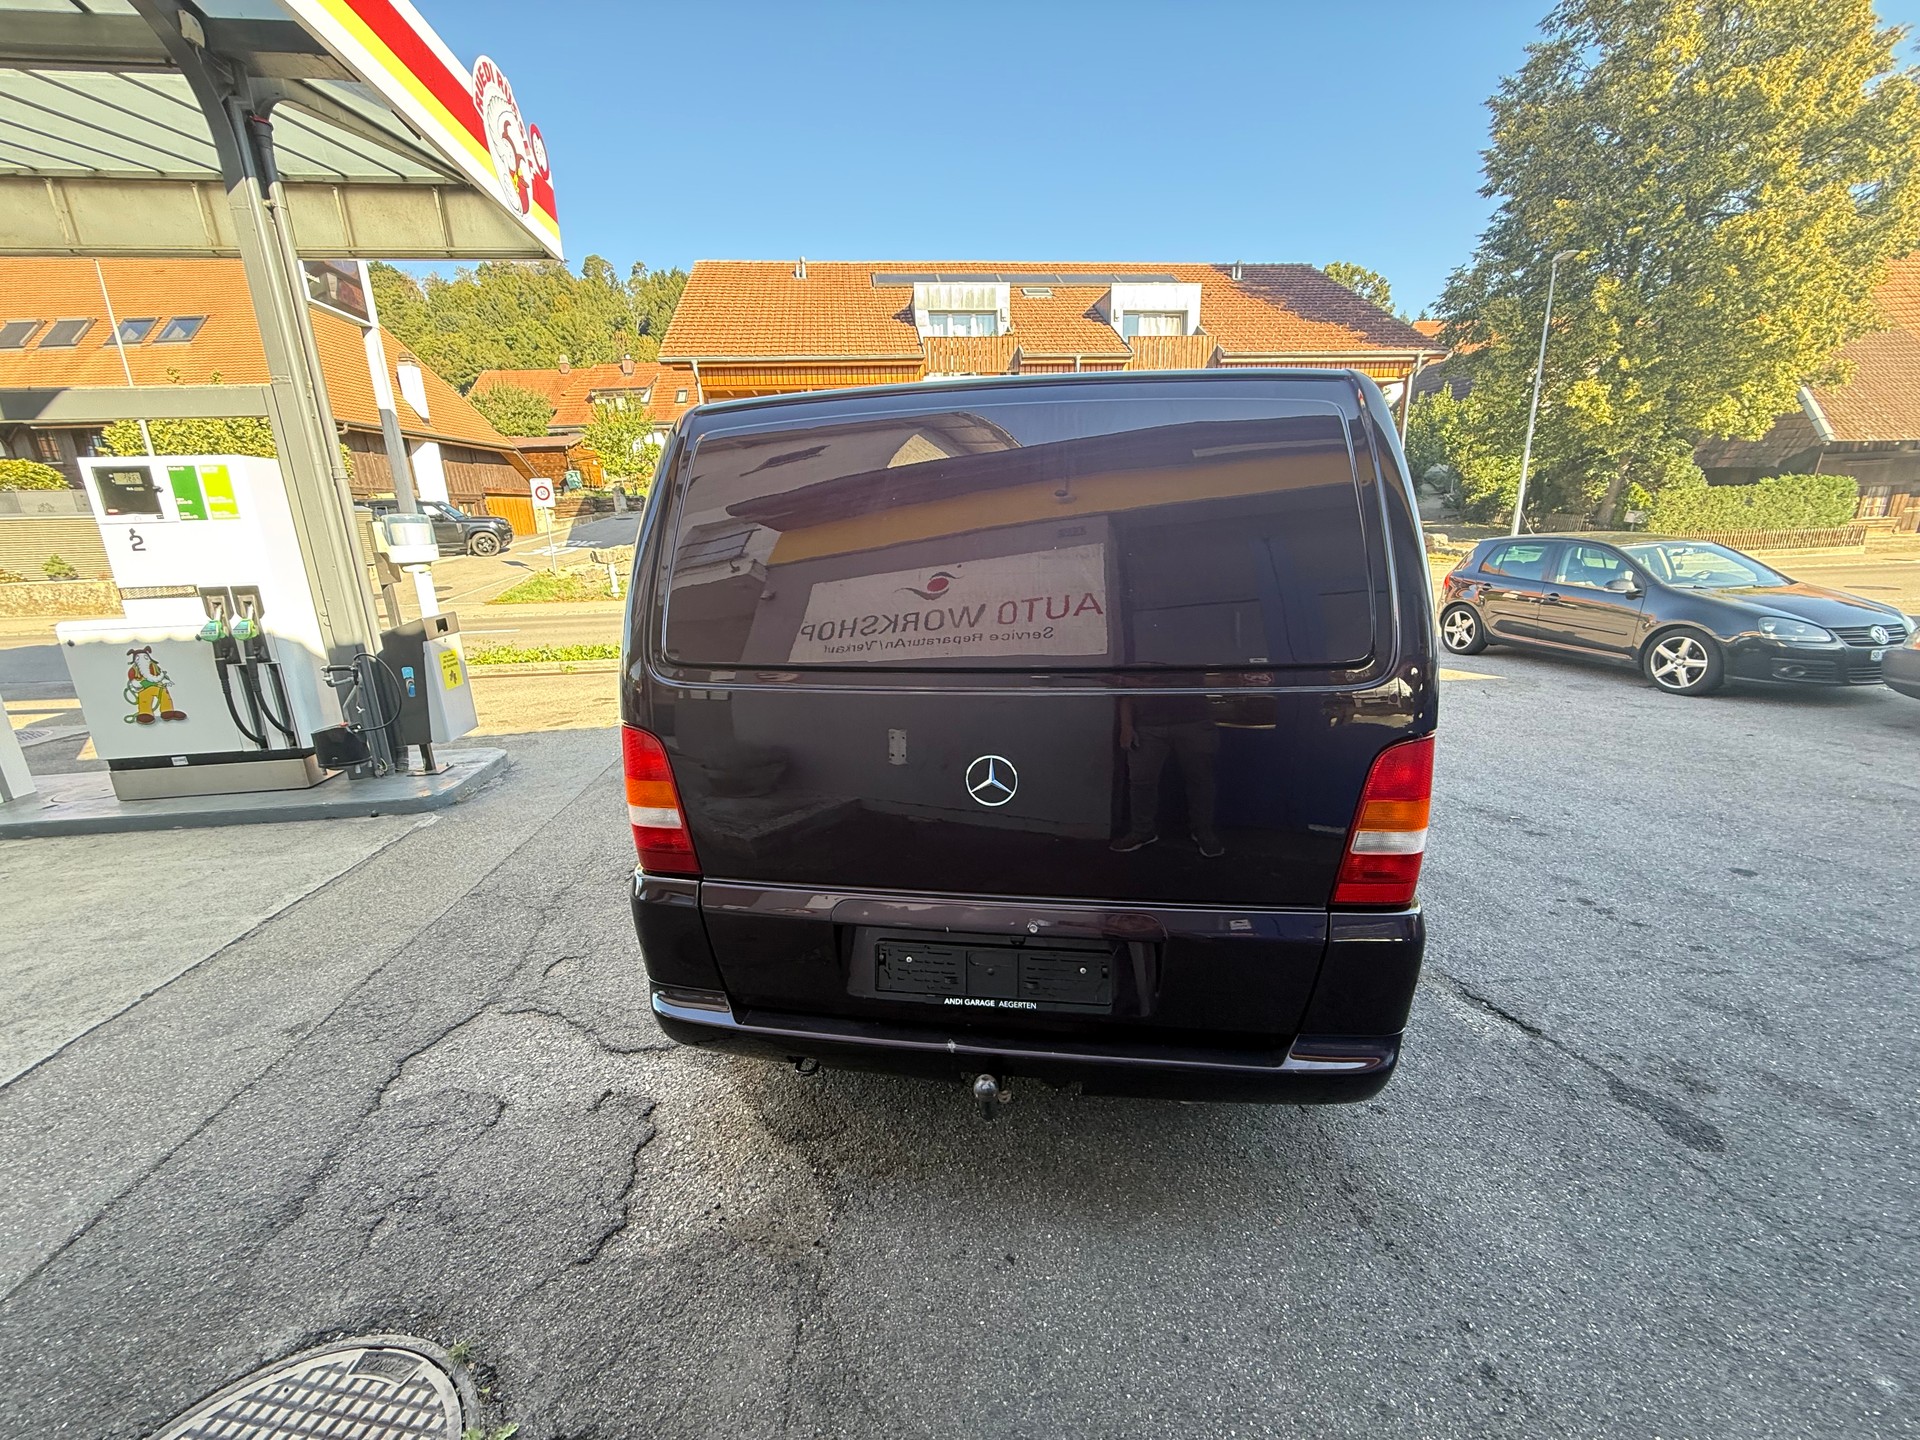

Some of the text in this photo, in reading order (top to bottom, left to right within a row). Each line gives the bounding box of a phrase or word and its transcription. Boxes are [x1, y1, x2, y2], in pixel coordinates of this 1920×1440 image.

[475, 61, 496, 117] RUEDI
[964, 998, 995, 1007] GARAGE
[998, 1000, 1037, 1009] AEGERTEN
